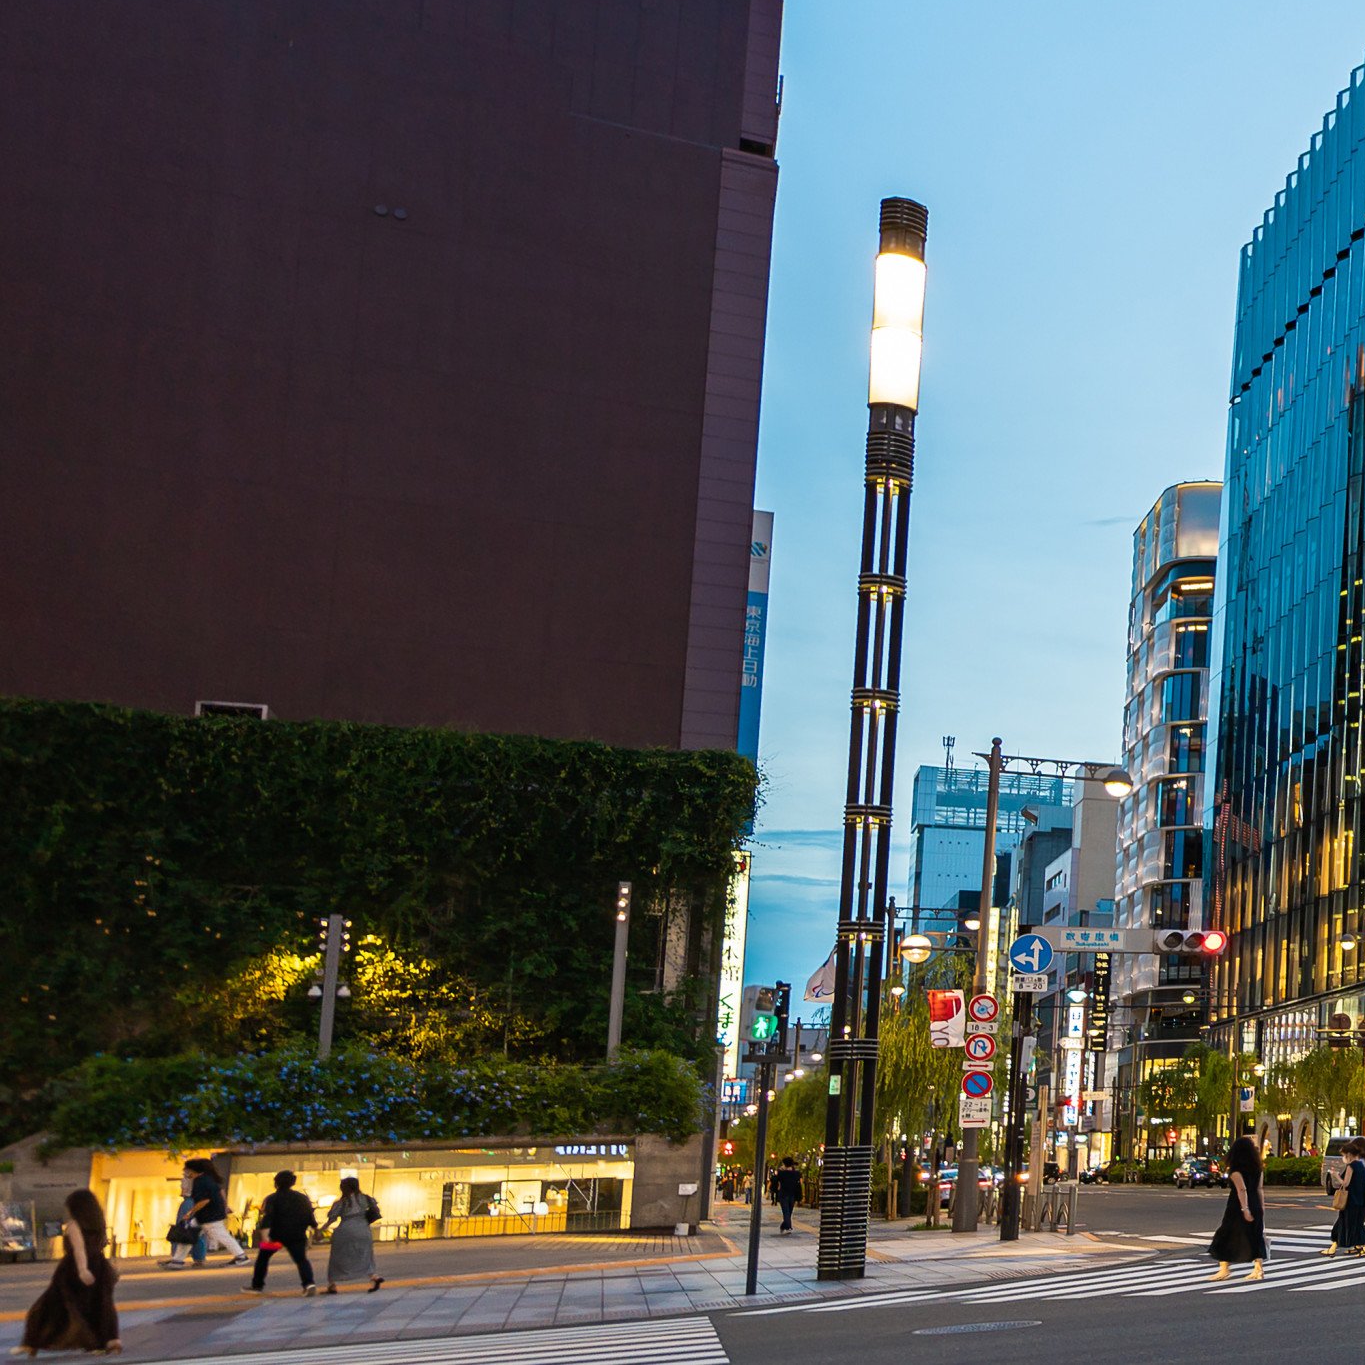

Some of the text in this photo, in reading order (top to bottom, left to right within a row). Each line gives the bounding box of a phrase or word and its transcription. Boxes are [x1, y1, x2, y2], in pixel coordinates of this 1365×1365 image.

[741, 605, 762, 688] 東京海上日動
[931, 1019, 951, 1047] YO
